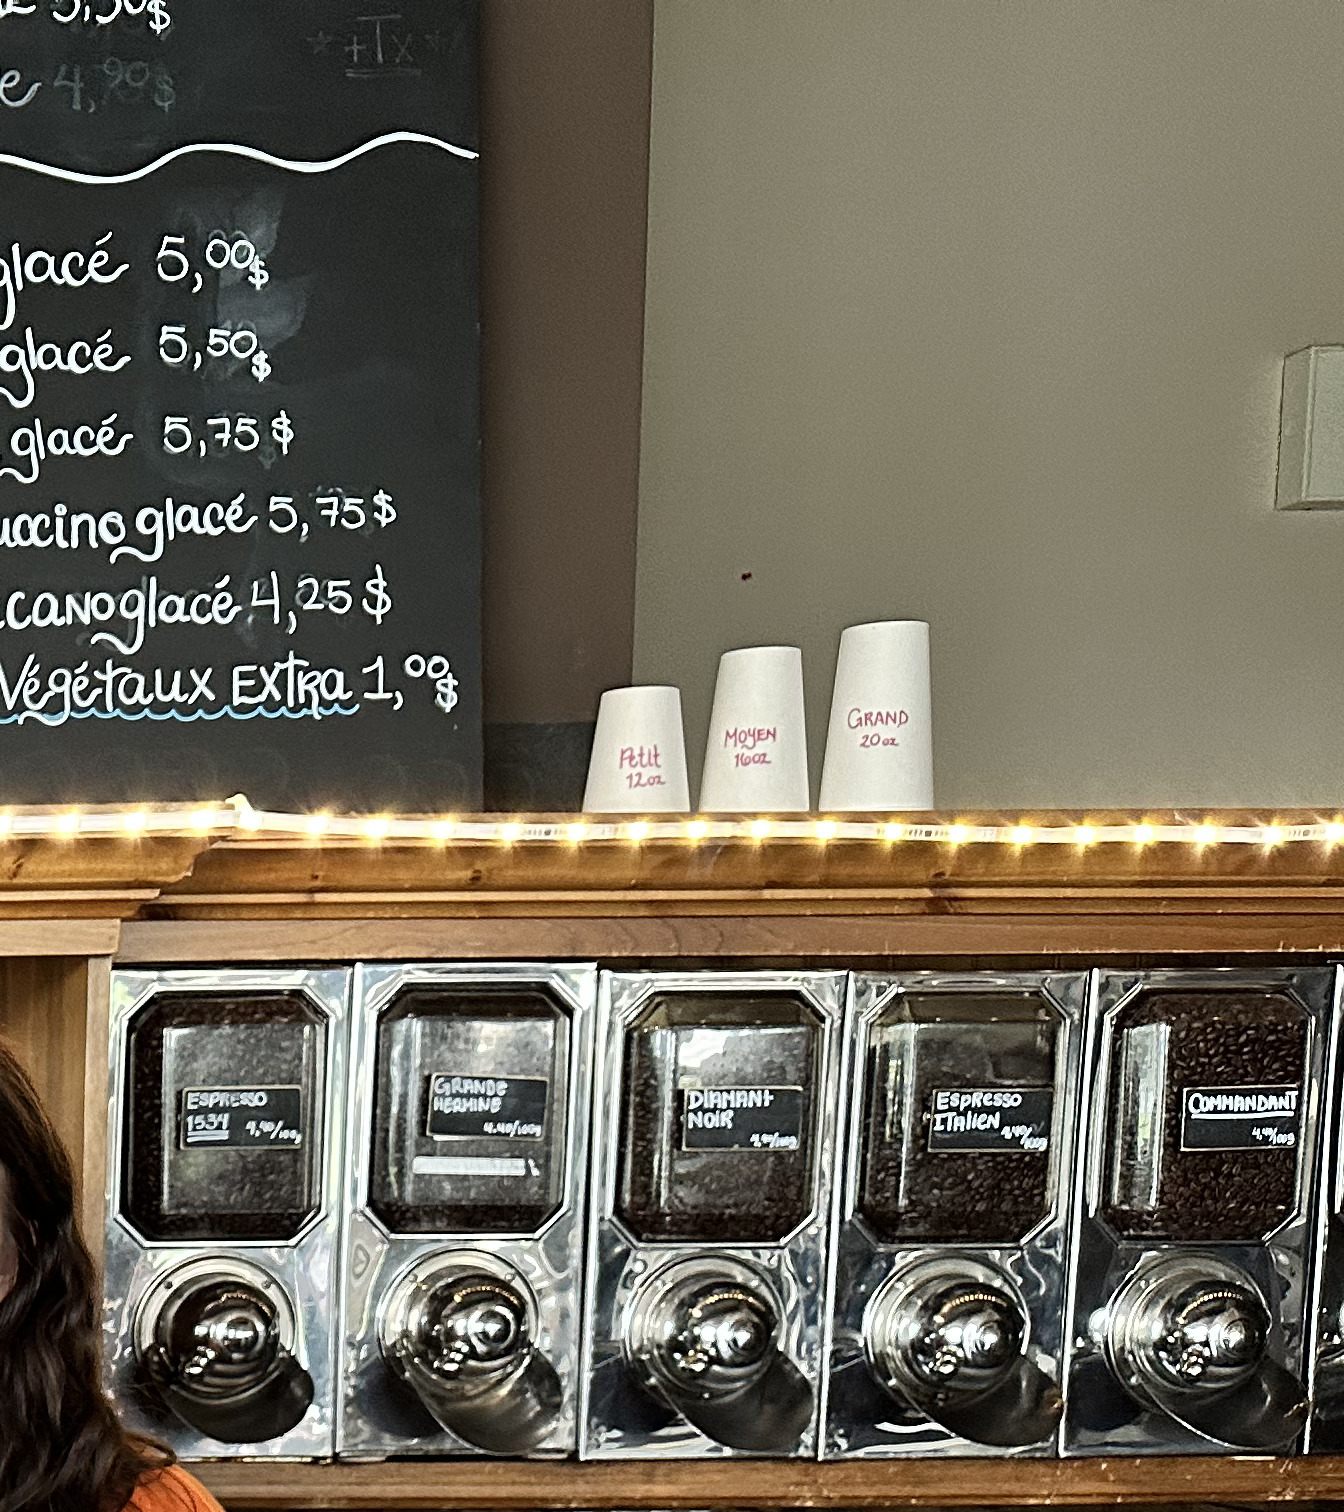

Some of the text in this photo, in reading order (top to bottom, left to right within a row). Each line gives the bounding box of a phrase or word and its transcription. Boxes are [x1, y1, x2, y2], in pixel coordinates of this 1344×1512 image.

[156, 234, 269, 290] 5,00$
[158, 325, 272, 382] 5,50$
[162, 410, 296, 458] 5,75$
[109, 492, 258, 564] glacé
[91, 574, 242, 655] glacé
[847, 708, 909, 729] GRAND
[1188, 1090, 1299, 1114] COMMANDANT
